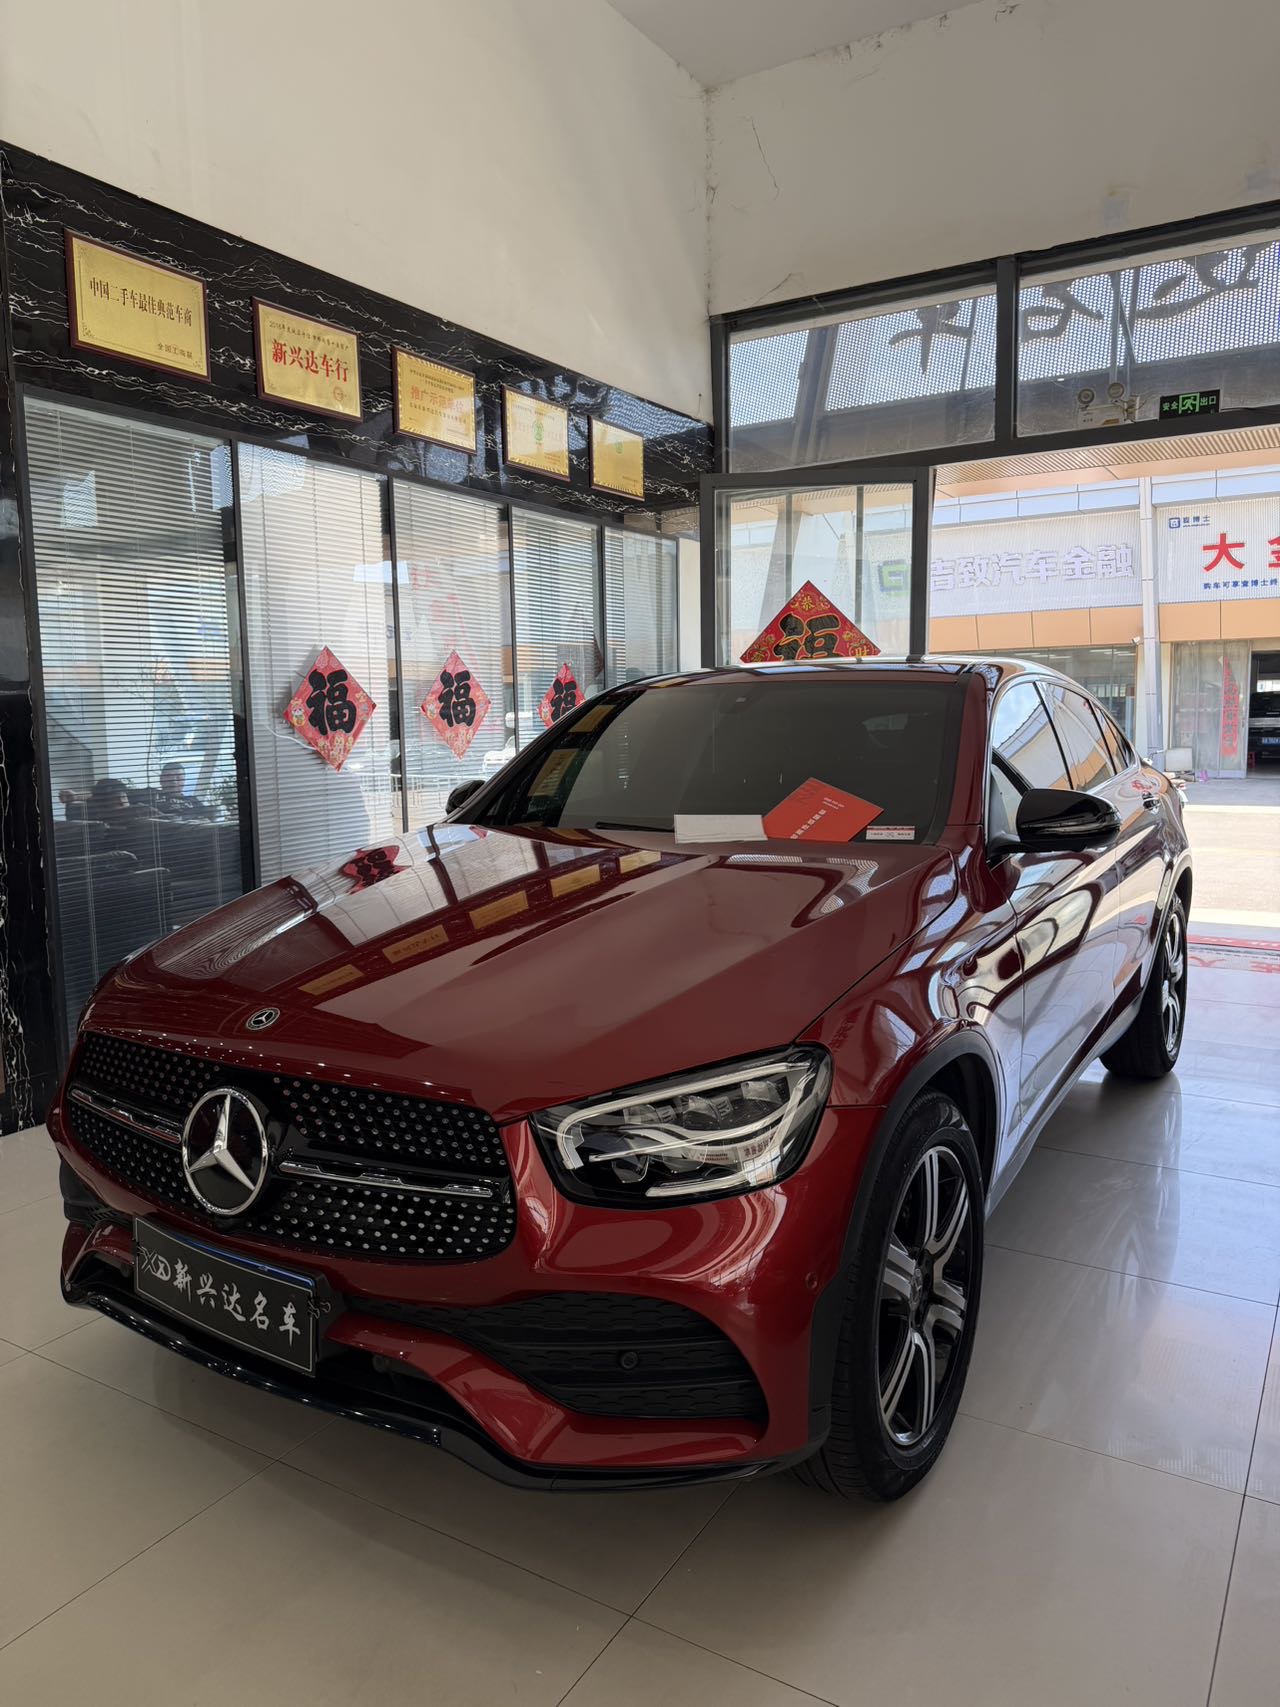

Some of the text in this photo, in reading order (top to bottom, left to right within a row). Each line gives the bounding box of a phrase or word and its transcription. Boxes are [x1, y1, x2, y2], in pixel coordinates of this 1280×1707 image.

[89, 277, 192, 327] 中国二手车最佳典范车商
[272, 338, 349, 382] 新兴达车行
[1162, 396, 1216, 411] 安全 出口
[931, 543, 1134, 592] 吉致汽车金融
[306, 669, 357, 736] 福
[438, 669, 476, 728] 福
[173, 1258, 301, 1346] 新兴达名车
